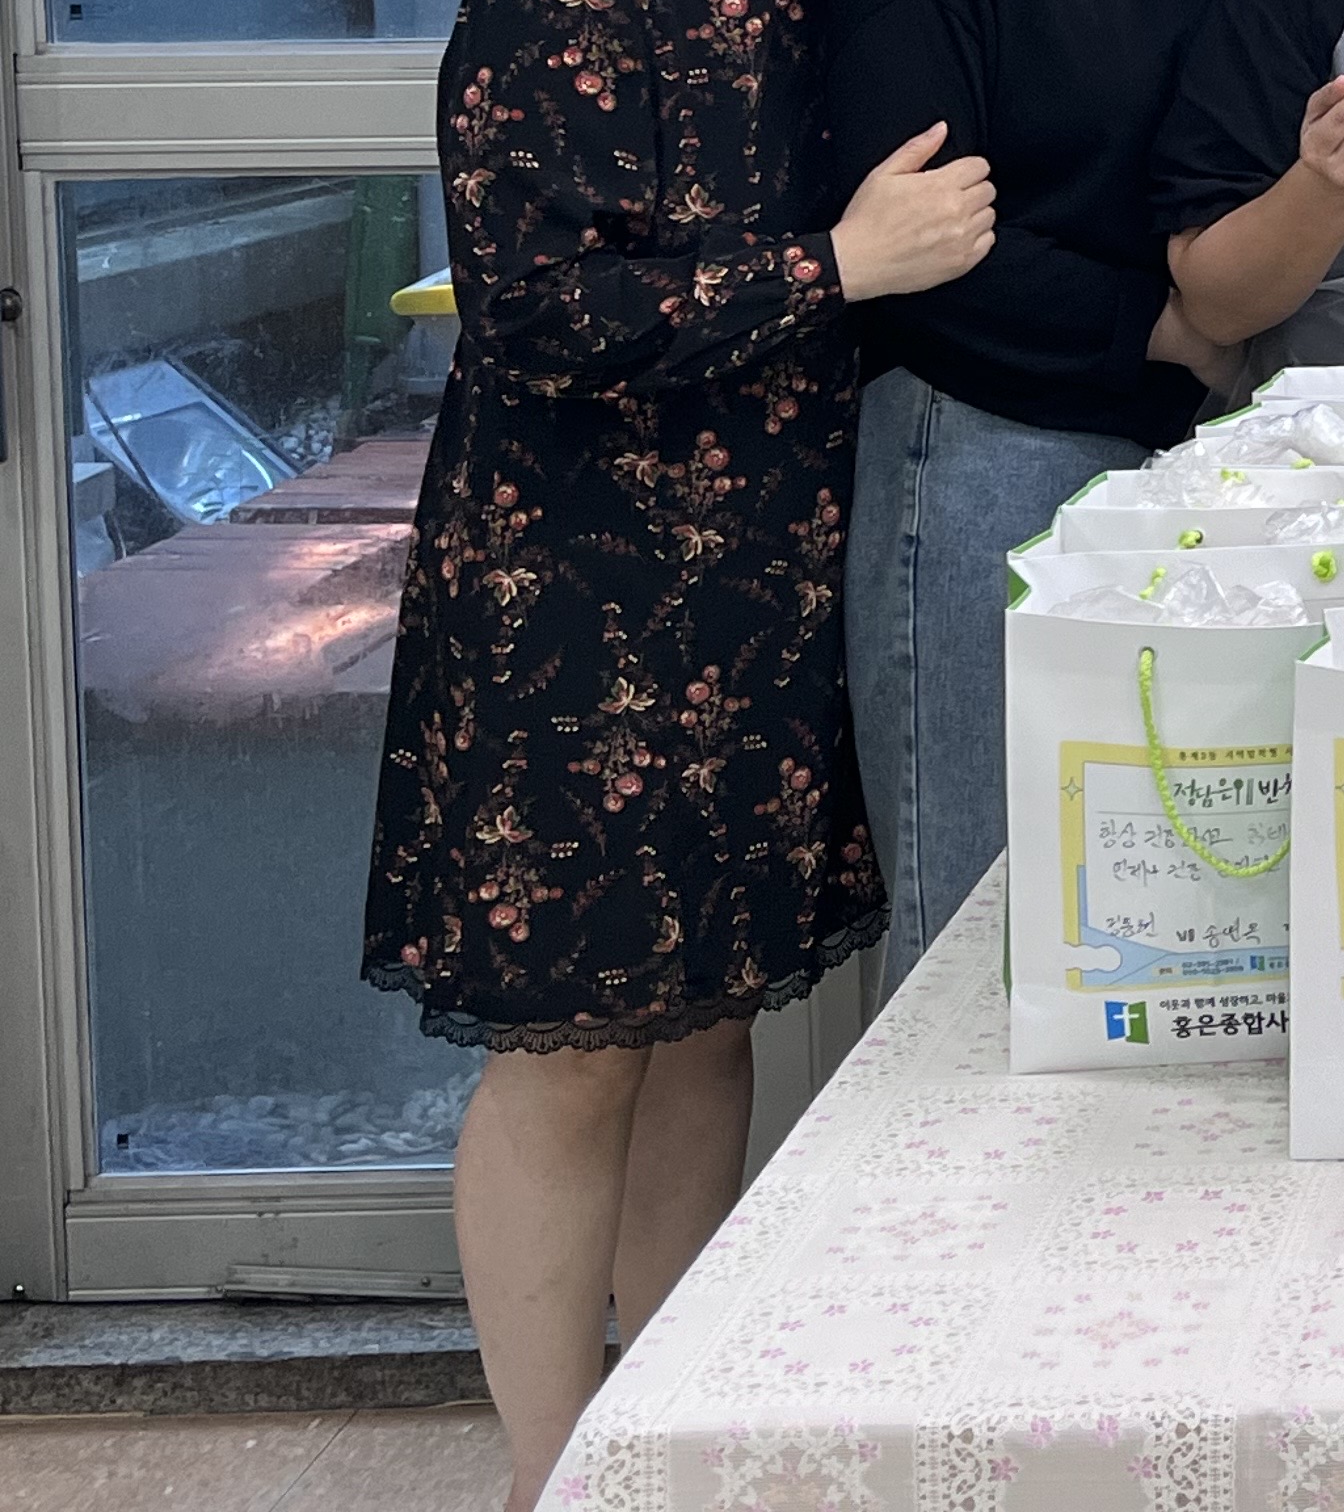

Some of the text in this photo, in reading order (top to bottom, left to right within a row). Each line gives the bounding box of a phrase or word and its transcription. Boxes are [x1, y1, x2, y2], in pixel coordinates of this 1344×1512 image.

[1160, 997, 1191, 1012] 이웃과
[1194, 996, 1216, 1010] 함께
[1265, 992, 1289, 1004] 마을
